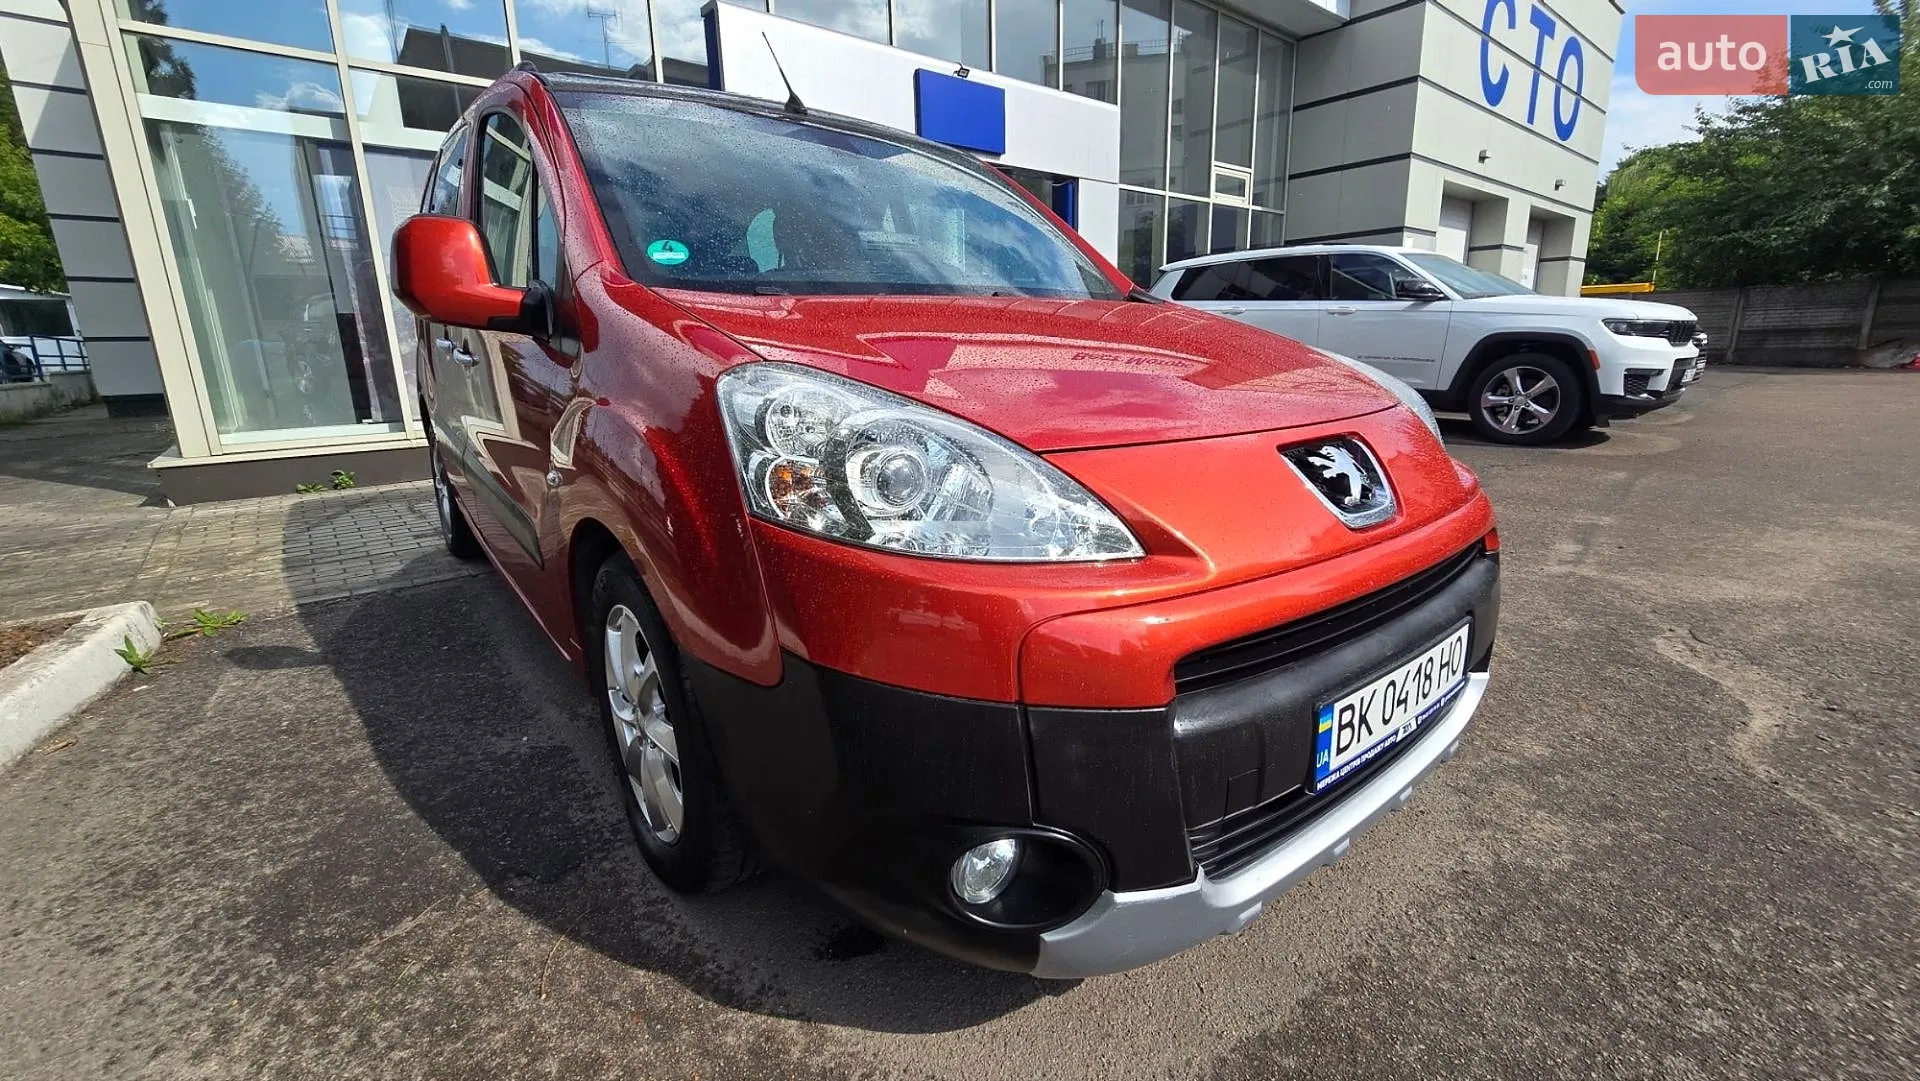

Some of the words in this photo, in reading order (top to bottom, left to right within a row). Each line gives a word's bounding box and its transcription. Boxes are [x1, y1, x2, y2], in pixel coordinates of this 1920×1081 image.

[662, 240, 674, 252] 4
[1336, 689, 1378, 757] BK
[1381, 656, 1433, 726] 0418
[1437, 635, 1463, 690] HO
[1316, 748, 1329, 769] UA
